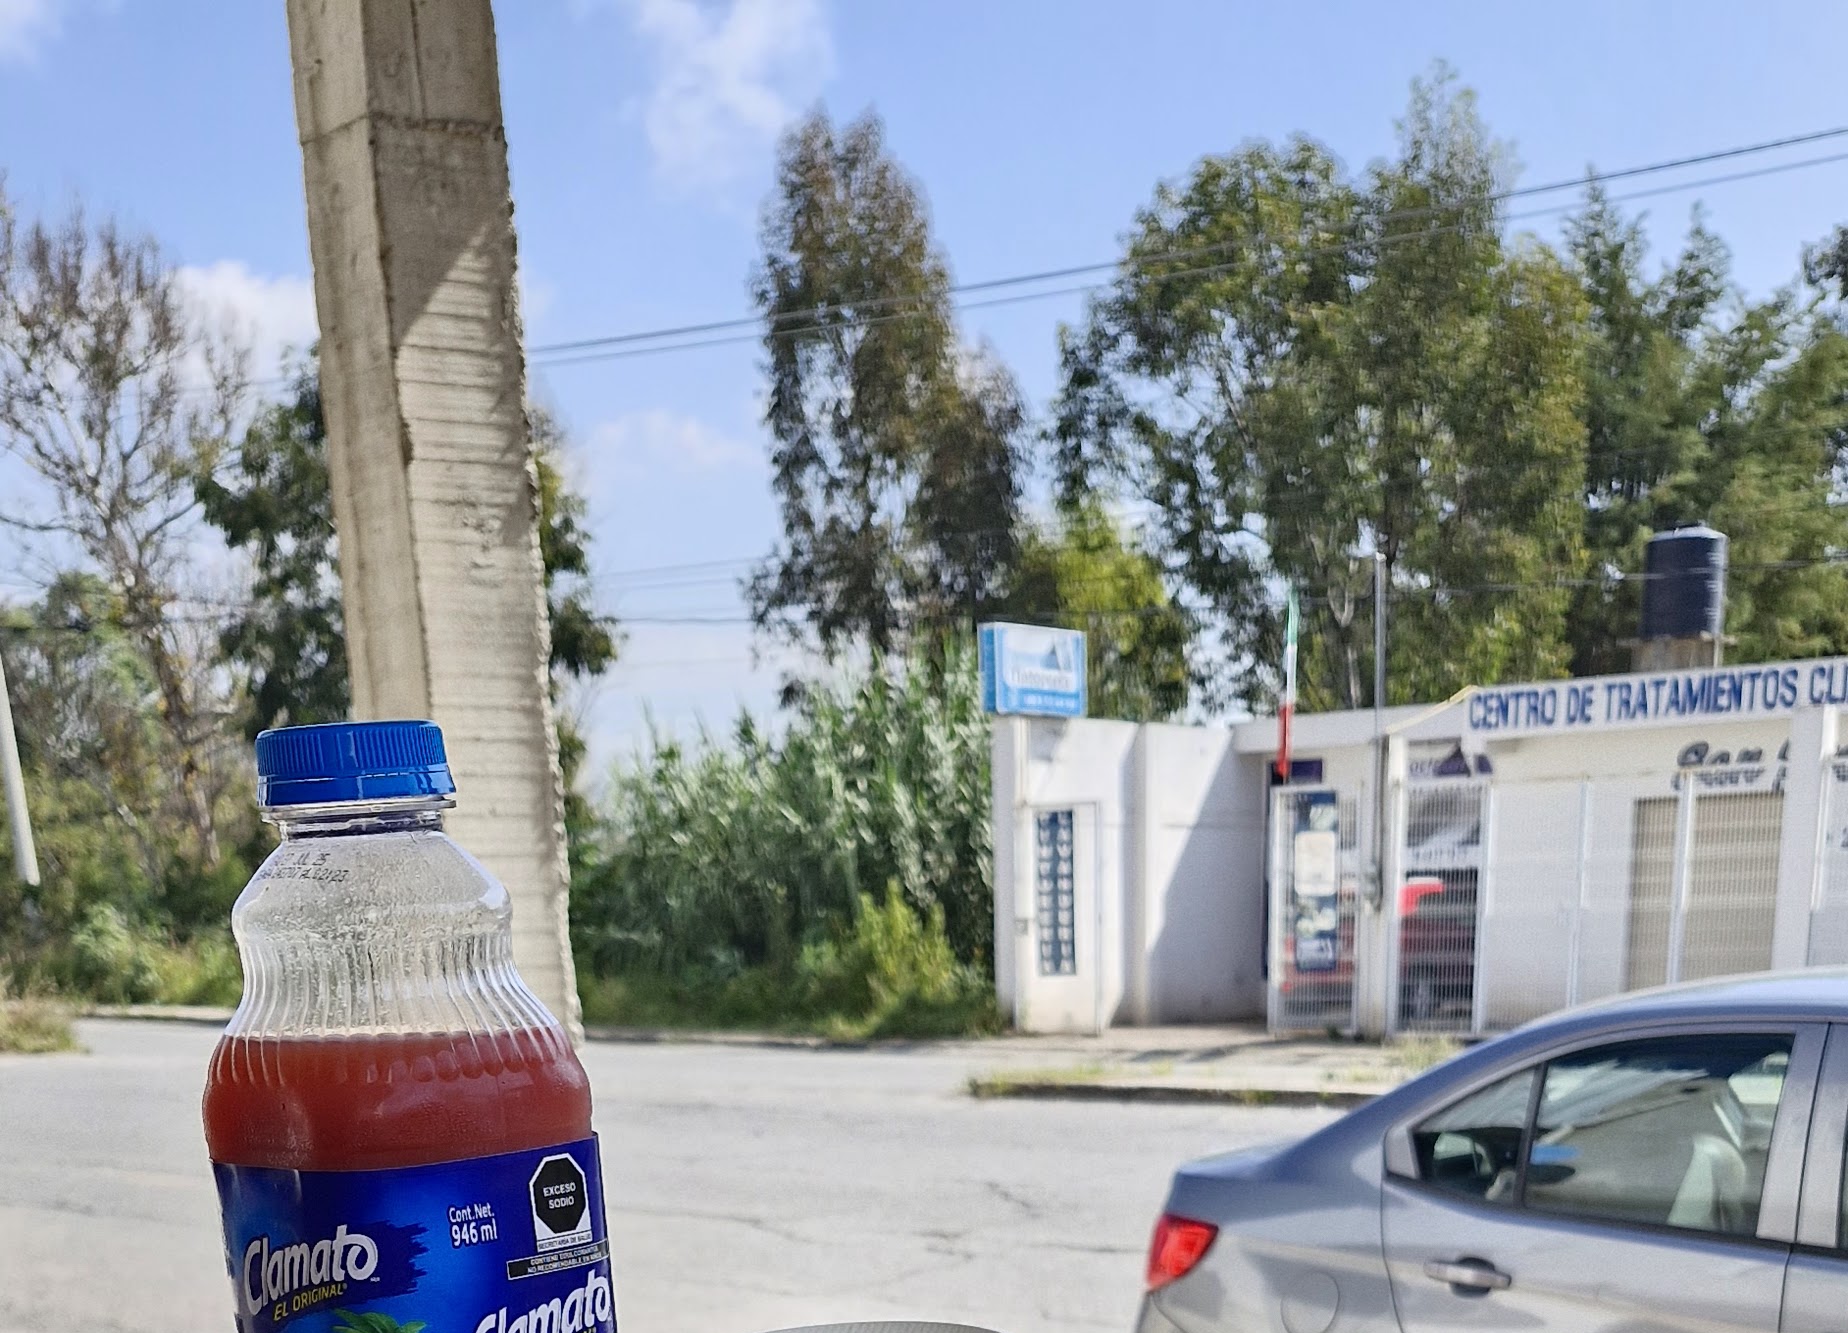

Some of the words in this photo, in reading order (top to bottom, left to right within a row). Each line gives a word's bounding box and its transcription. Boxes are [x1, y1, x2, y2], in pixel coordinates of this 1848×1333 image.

[1469, 688, 1556, 730] CENTRO
[1567, 685, 1594, 724] DE
[1606, 668, 1798, 722] TRATAMIENTOS
[543, 1182, 576, 1197] EXCESO
[548, 1196, 575, 1209] SODIO
[451, 1222, 479, 1247] 946
[481, 1219, 498, 1243] ml
[244, 1224, 378, 1316] Clamato
[273, 1302, 289, 1321] EL
